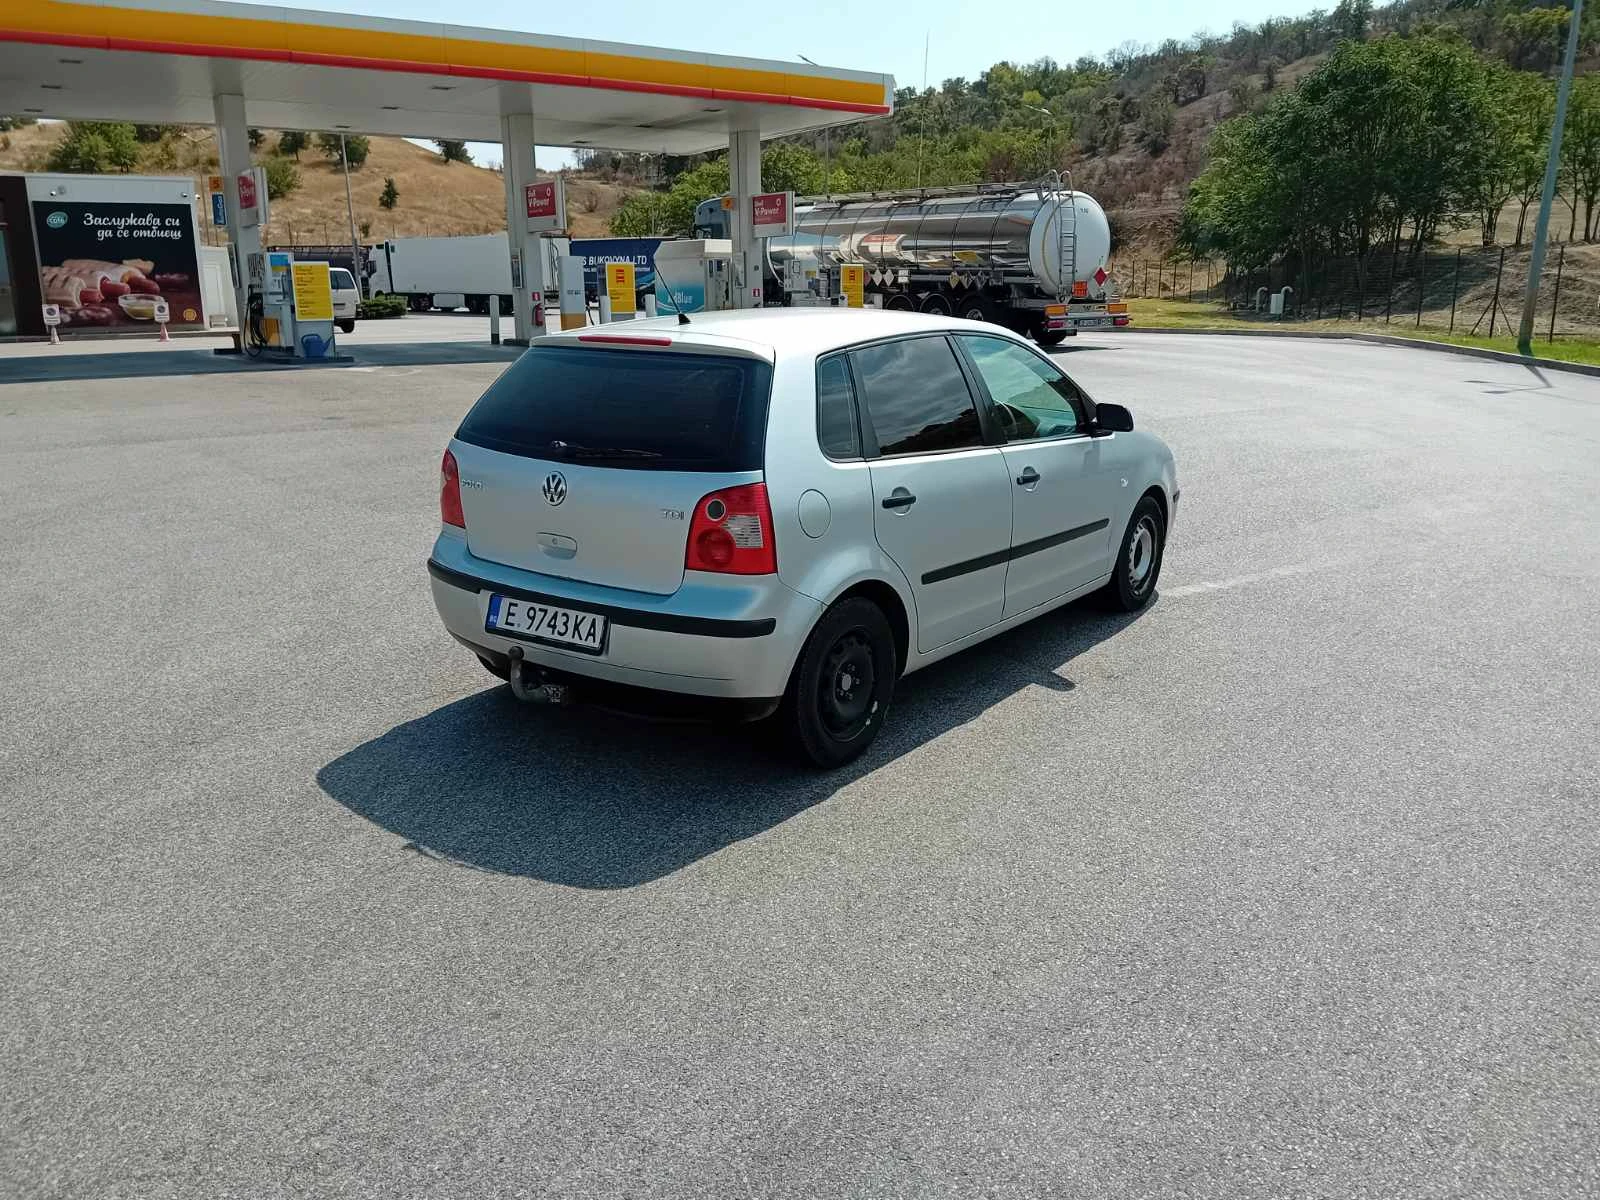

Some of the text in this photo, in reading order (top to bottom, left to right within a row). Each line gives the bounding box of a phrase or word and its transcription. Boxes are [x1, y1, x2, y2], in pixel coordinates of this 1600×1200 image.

[83, 212, 180, 229] Заслужава си
[97, 229, 113, 241] да
[117, 229, 129, 238] се
[632, 255, 647, 265] LTD
[505, 602, 518, 627] E
